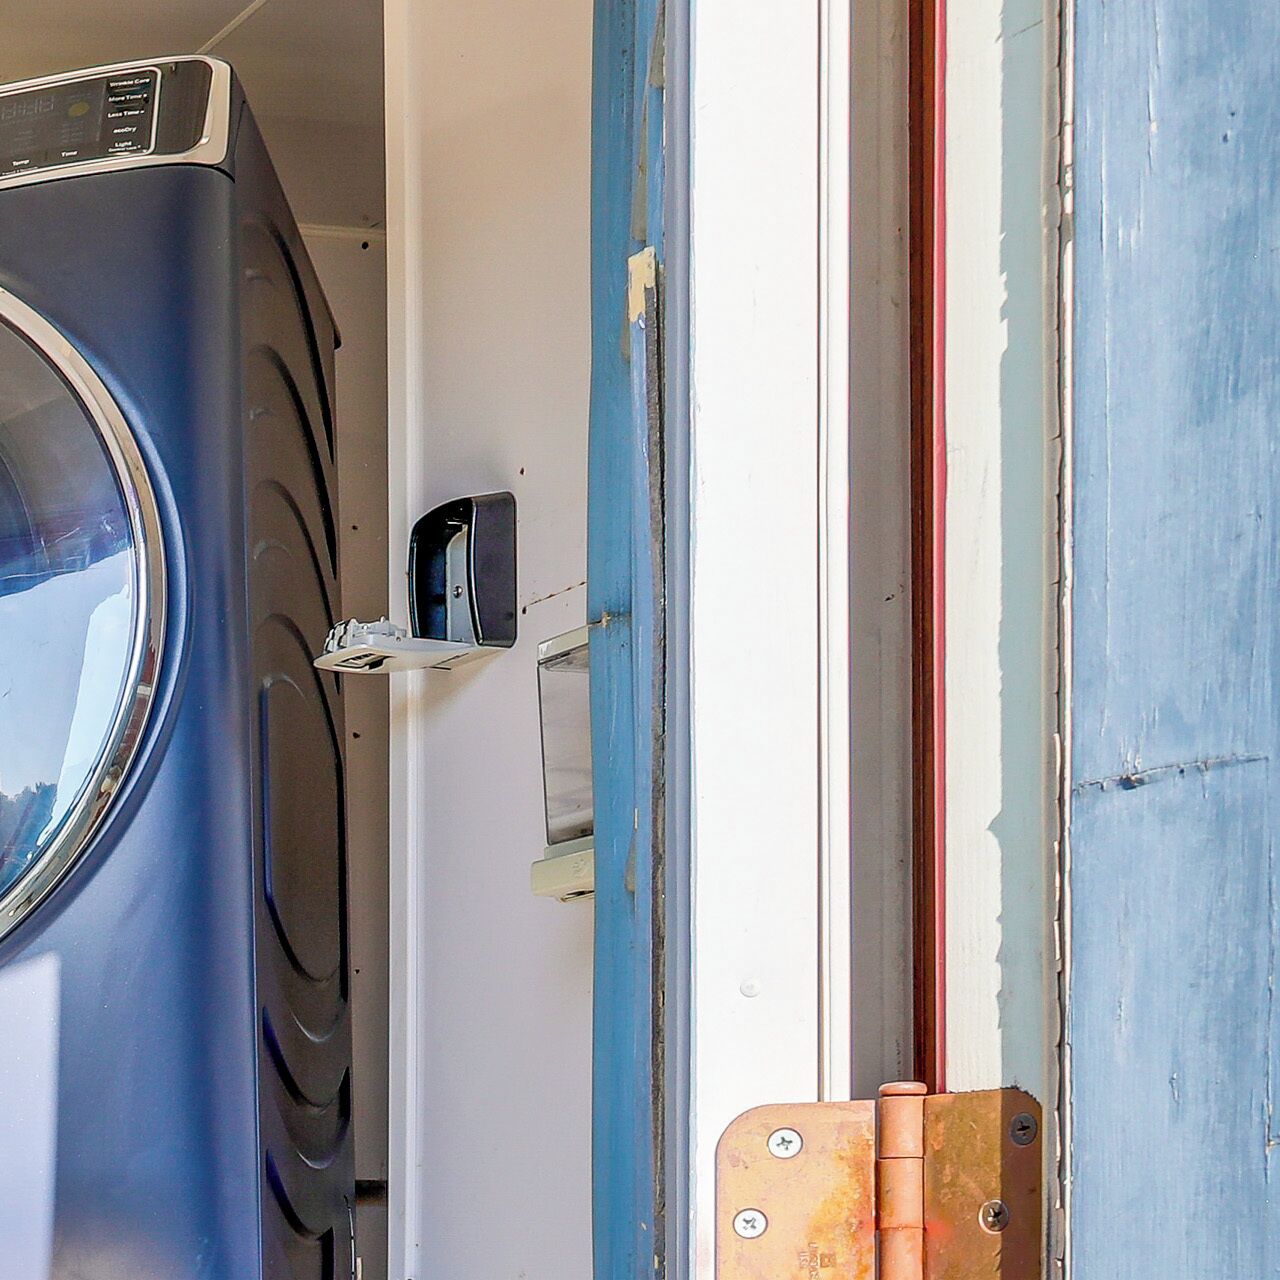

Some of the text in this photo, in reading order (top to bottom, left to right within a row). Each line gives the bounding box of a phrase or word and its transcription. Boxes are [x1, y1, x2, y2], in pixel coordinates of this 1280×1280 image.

[135, 77, 150, 85] Care
[108, 94, 125, 102] More
[115, 140, 132, 148] Light
[12, 159, 30, 167] Temp
